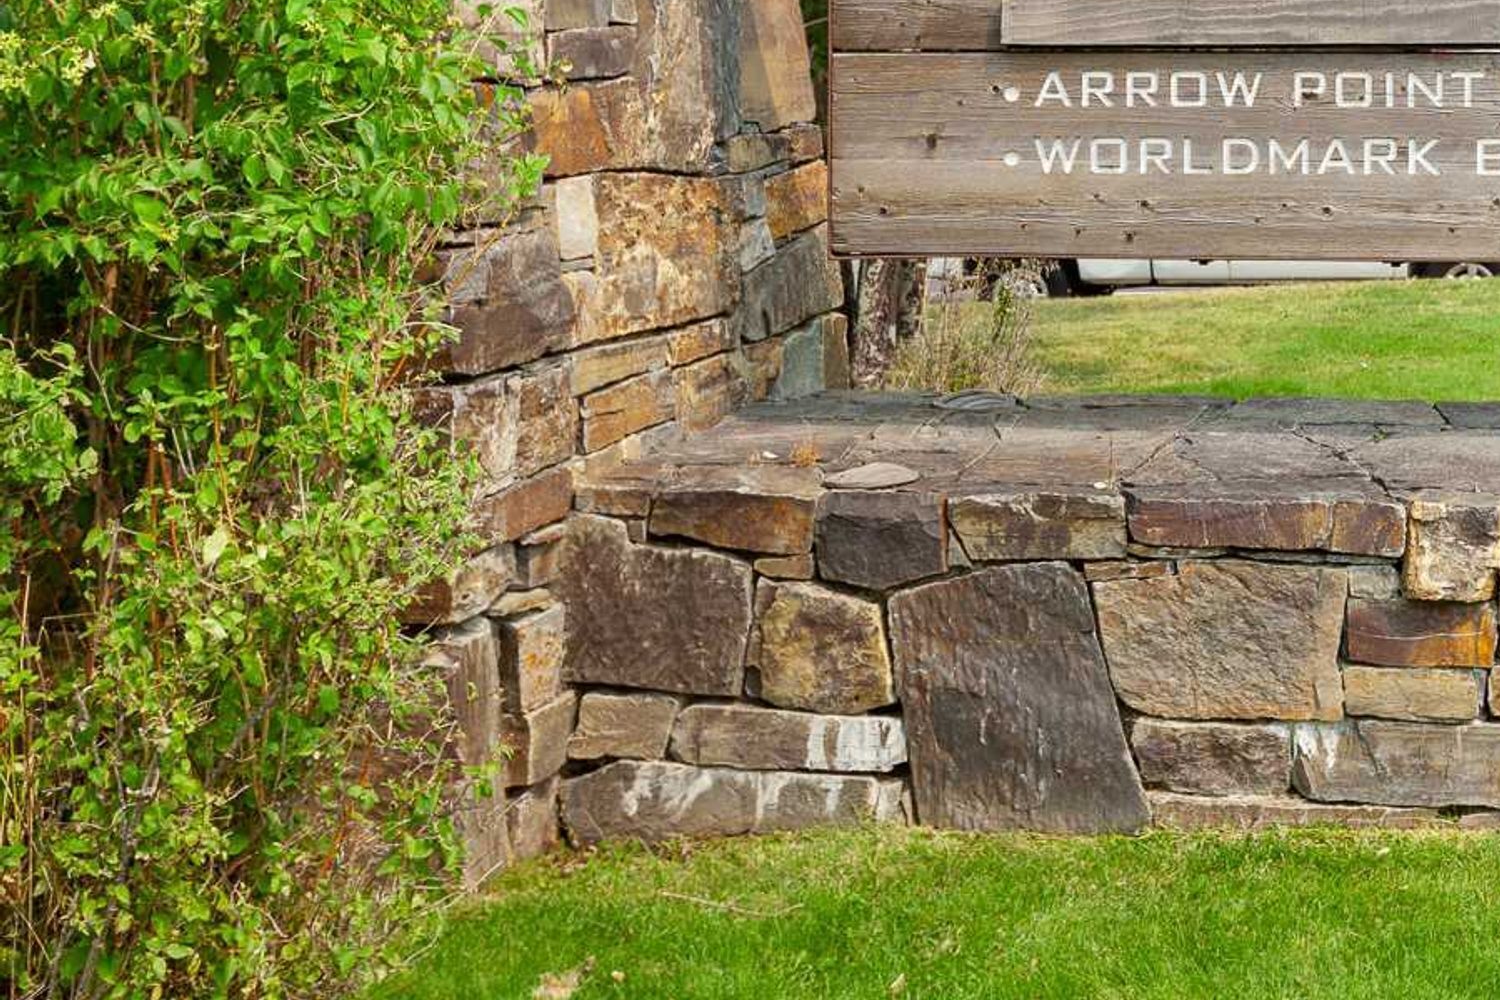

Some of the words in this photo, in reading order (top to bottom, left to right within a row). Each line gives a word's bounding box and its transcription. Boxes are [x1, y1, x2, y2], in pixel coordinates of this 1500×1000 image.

[1034, 71, 1262, 108] ARROW
[1293, 71, 1484, 108] POINT
[1034, 137, 1441, 176] WORLDMARK
